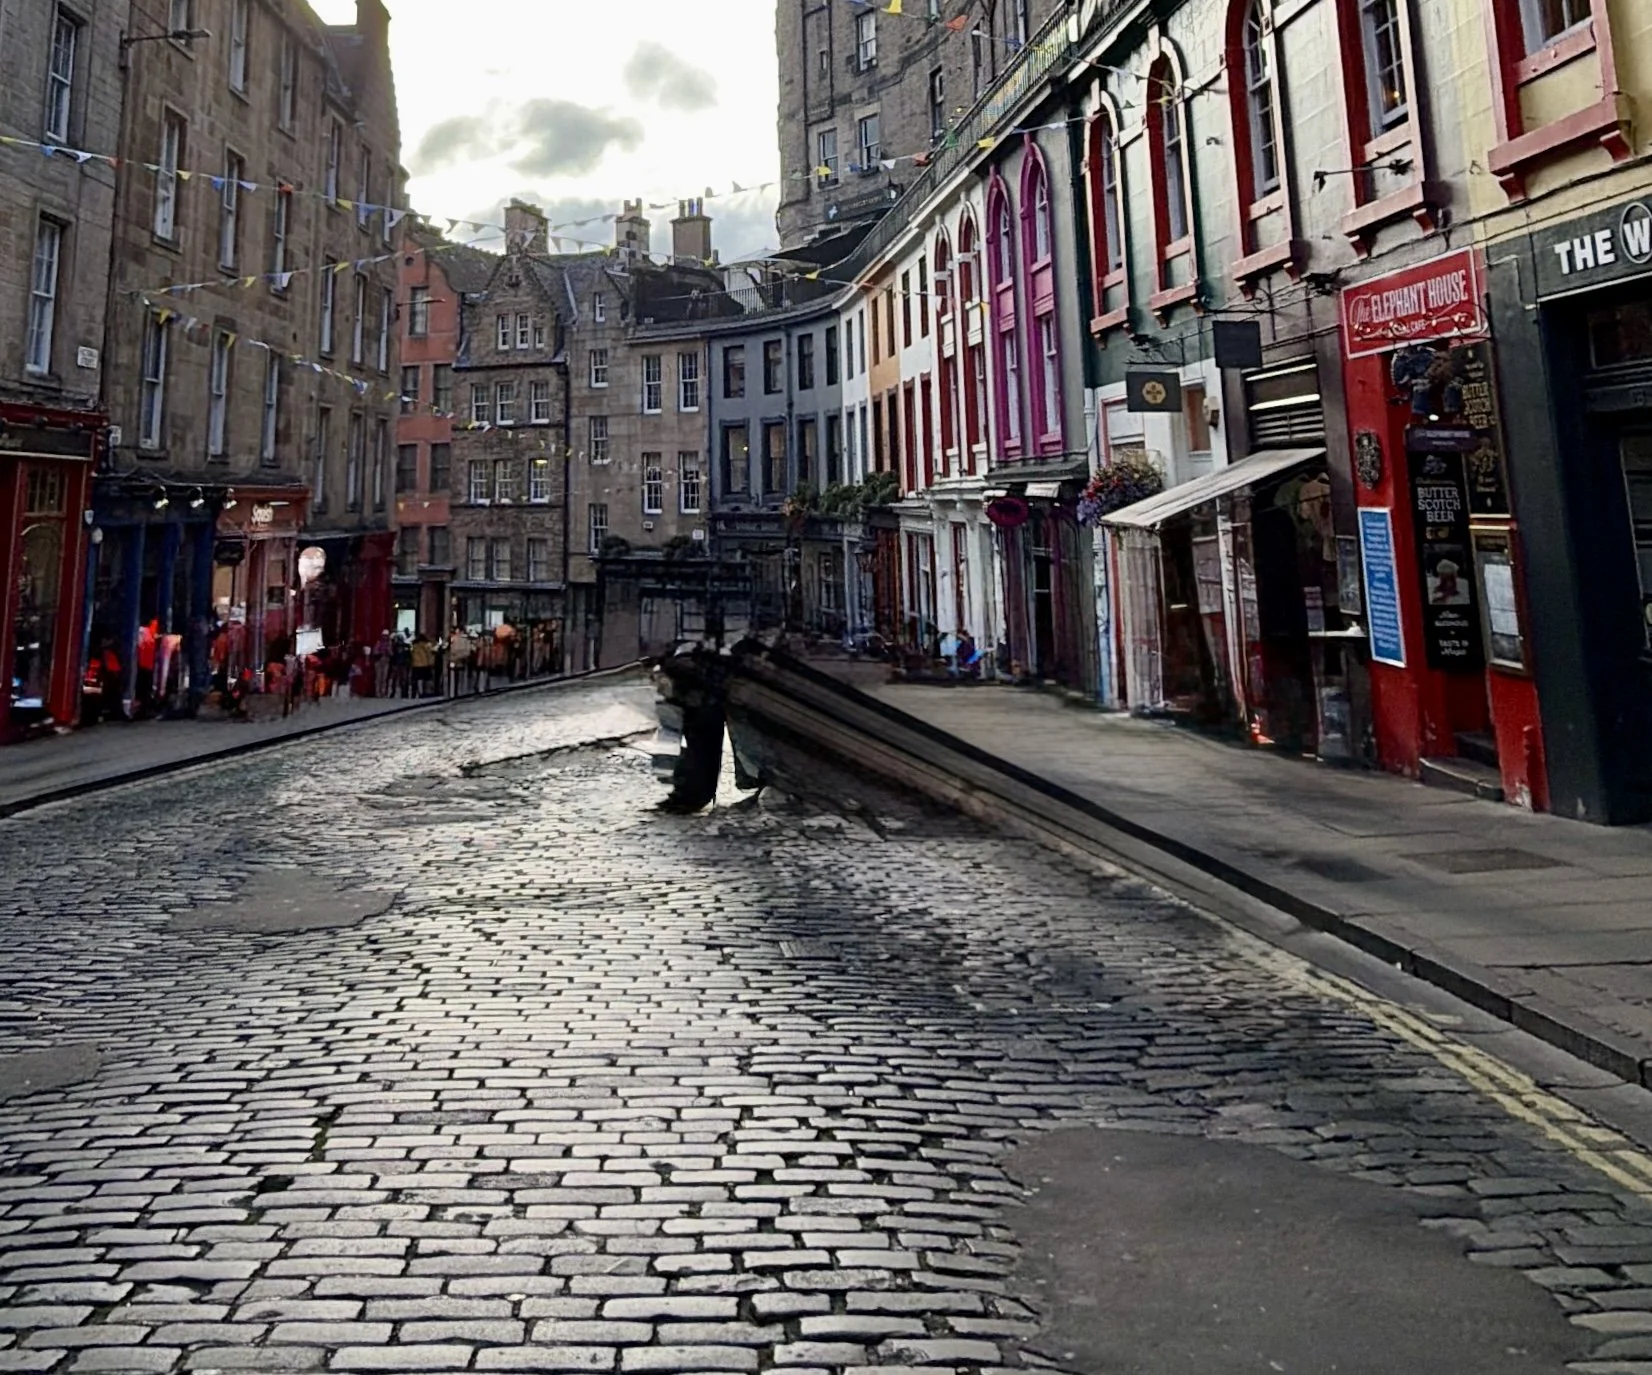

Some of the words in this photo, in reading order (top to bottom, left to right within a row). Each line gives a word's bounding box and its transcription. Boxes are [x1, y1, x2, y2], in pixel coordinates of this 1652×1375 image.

[1553, 229, 1615, 274] THE
[1351, 292, 1371, 326] The
[1371, 281, 1426, 323] ELEPHANT
[1428, 269, 1468, 308] HOUSE
[1417, 487, 1459, 498] BUTTER
[1418, 499, 1461, 510] SCOTCH
[1426, 511, 1455, 522] BEER
